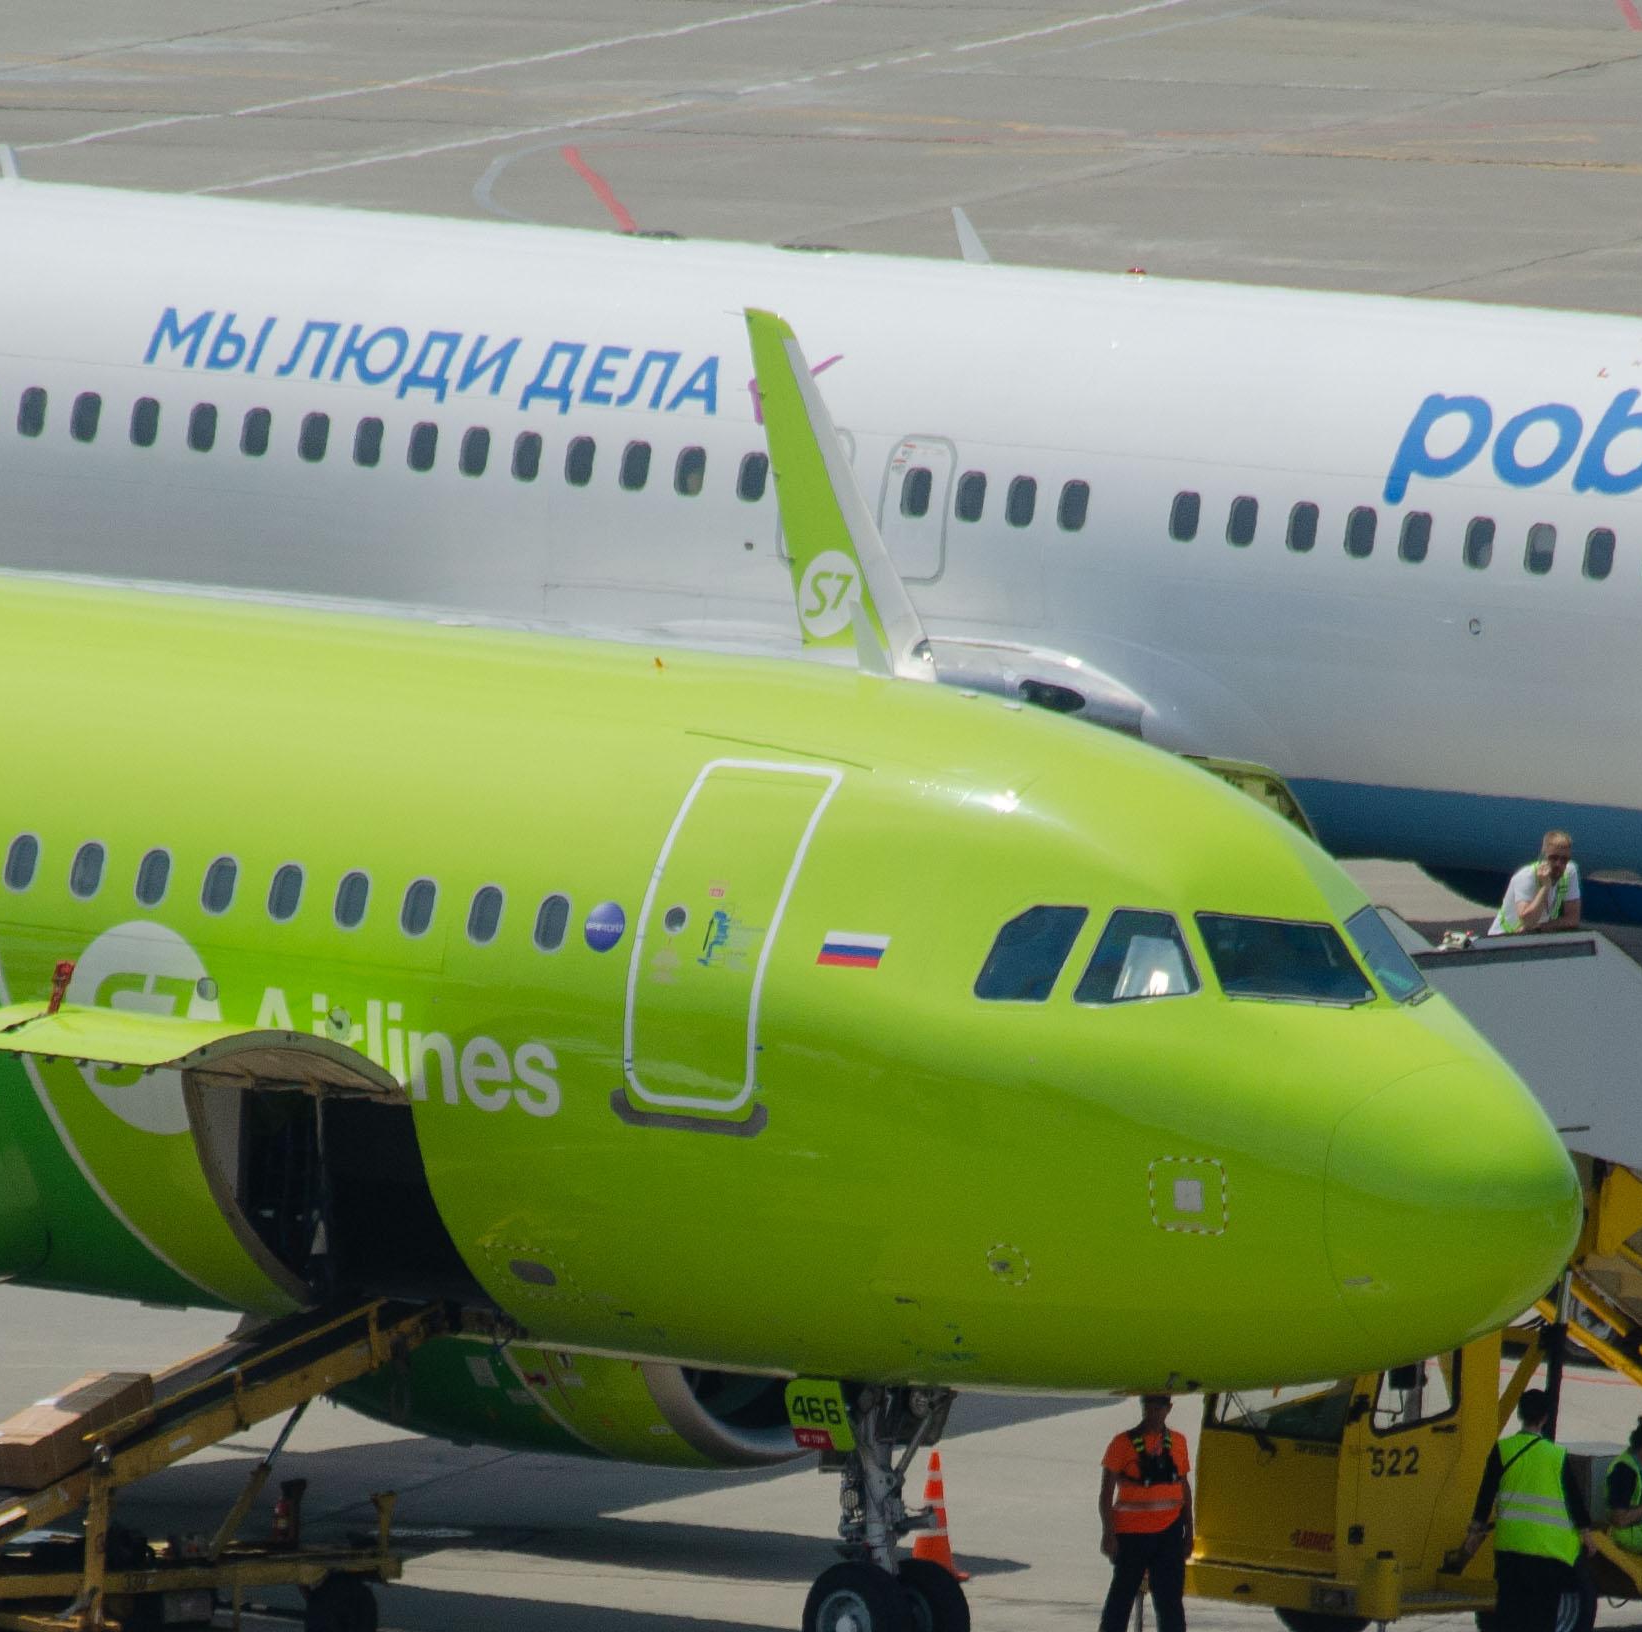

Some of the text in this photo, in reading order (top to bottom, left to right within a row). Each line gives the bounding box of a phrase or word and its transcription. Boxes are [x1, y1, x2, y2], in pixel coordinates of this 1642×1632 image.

[143, 306, 720, 415] МЫ ЛЮДИ ДЕЛА
[803, 570, 854, 619] S7
[792, 1395, 842, 1425] 466
[1369, 1445, 1420, 1478] 522
